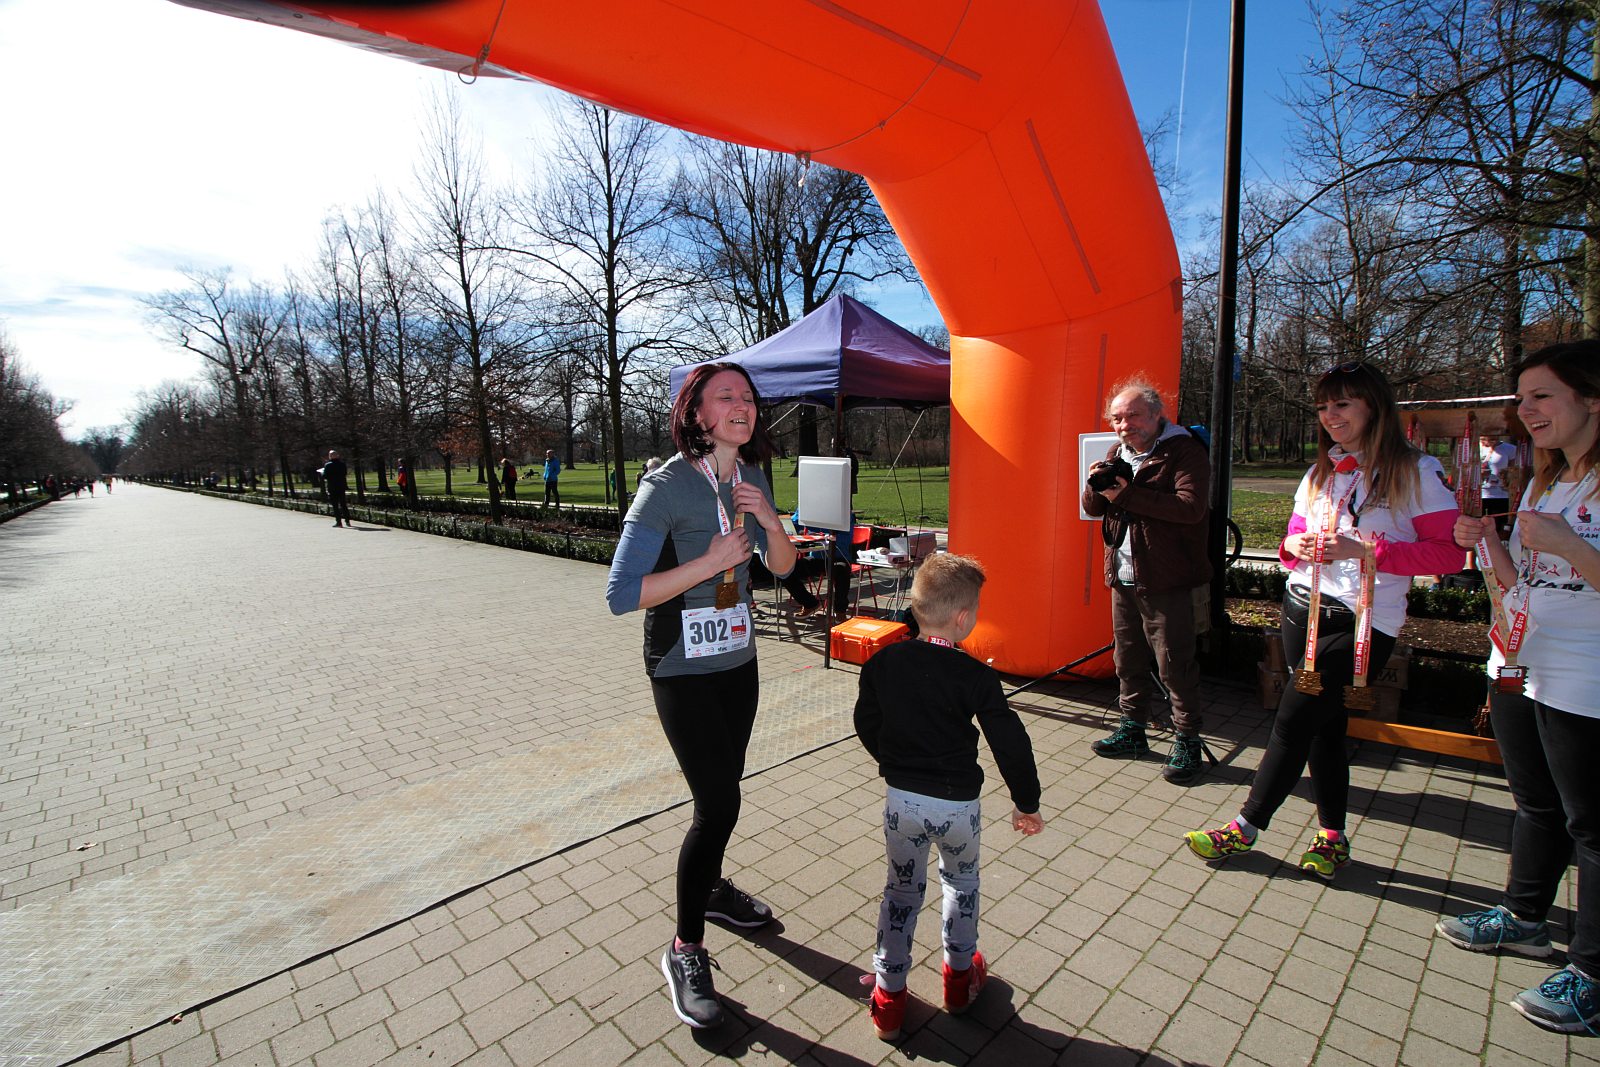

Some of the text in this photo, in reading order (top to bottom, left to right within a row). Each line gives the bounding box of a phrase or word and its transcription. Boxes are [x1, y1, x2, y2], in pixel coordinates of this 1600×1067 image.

[689, 618, 729, 645] 302
[930, 637, 950, 647] BIEG
[1509, 631, 1521, 651] BIEG
[1515, 615, 1525, 631] Stu
